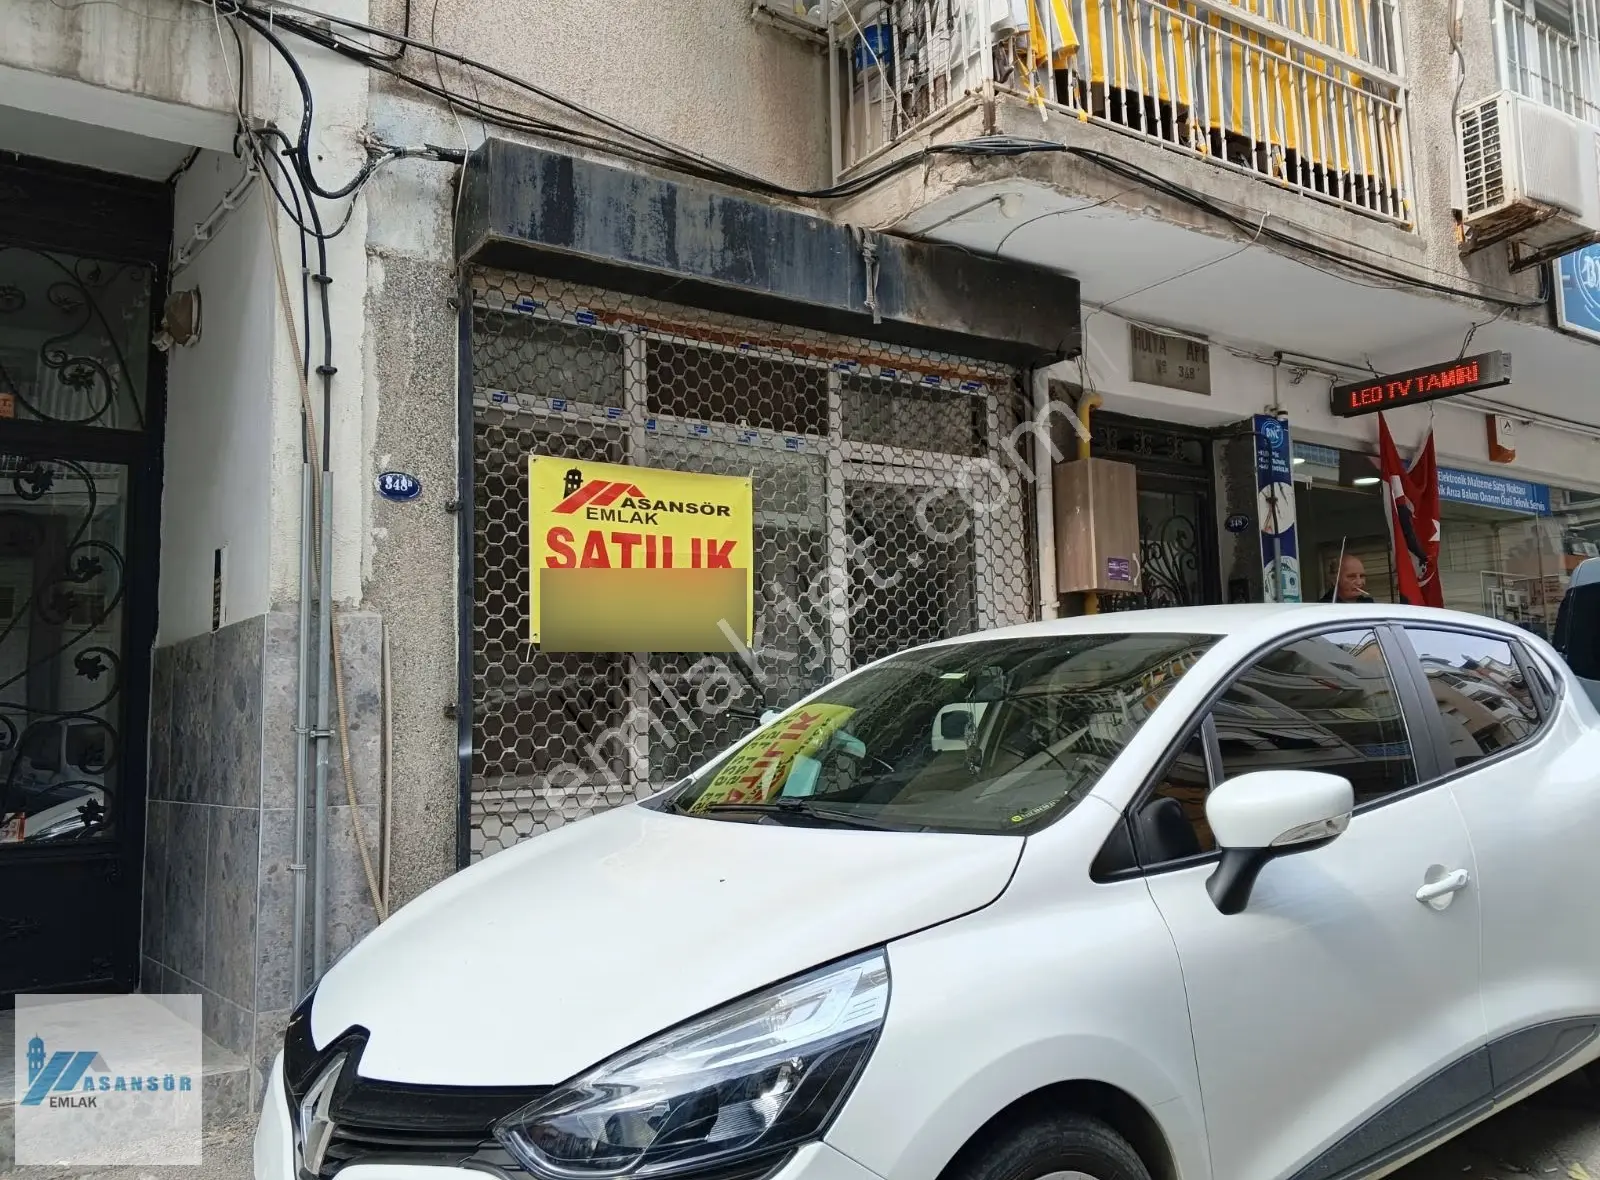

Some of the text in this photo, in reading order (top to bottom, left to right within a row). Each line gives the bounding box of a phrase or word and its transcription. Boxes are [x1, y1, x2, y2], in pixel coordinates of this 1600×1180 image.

[1351, 385, 1383, 408] LED
[1386, 378, 1413, 399] TV
[586, 506, 659, 525] EMLAK
[621, 497, 731, 517] ASANSÖR
